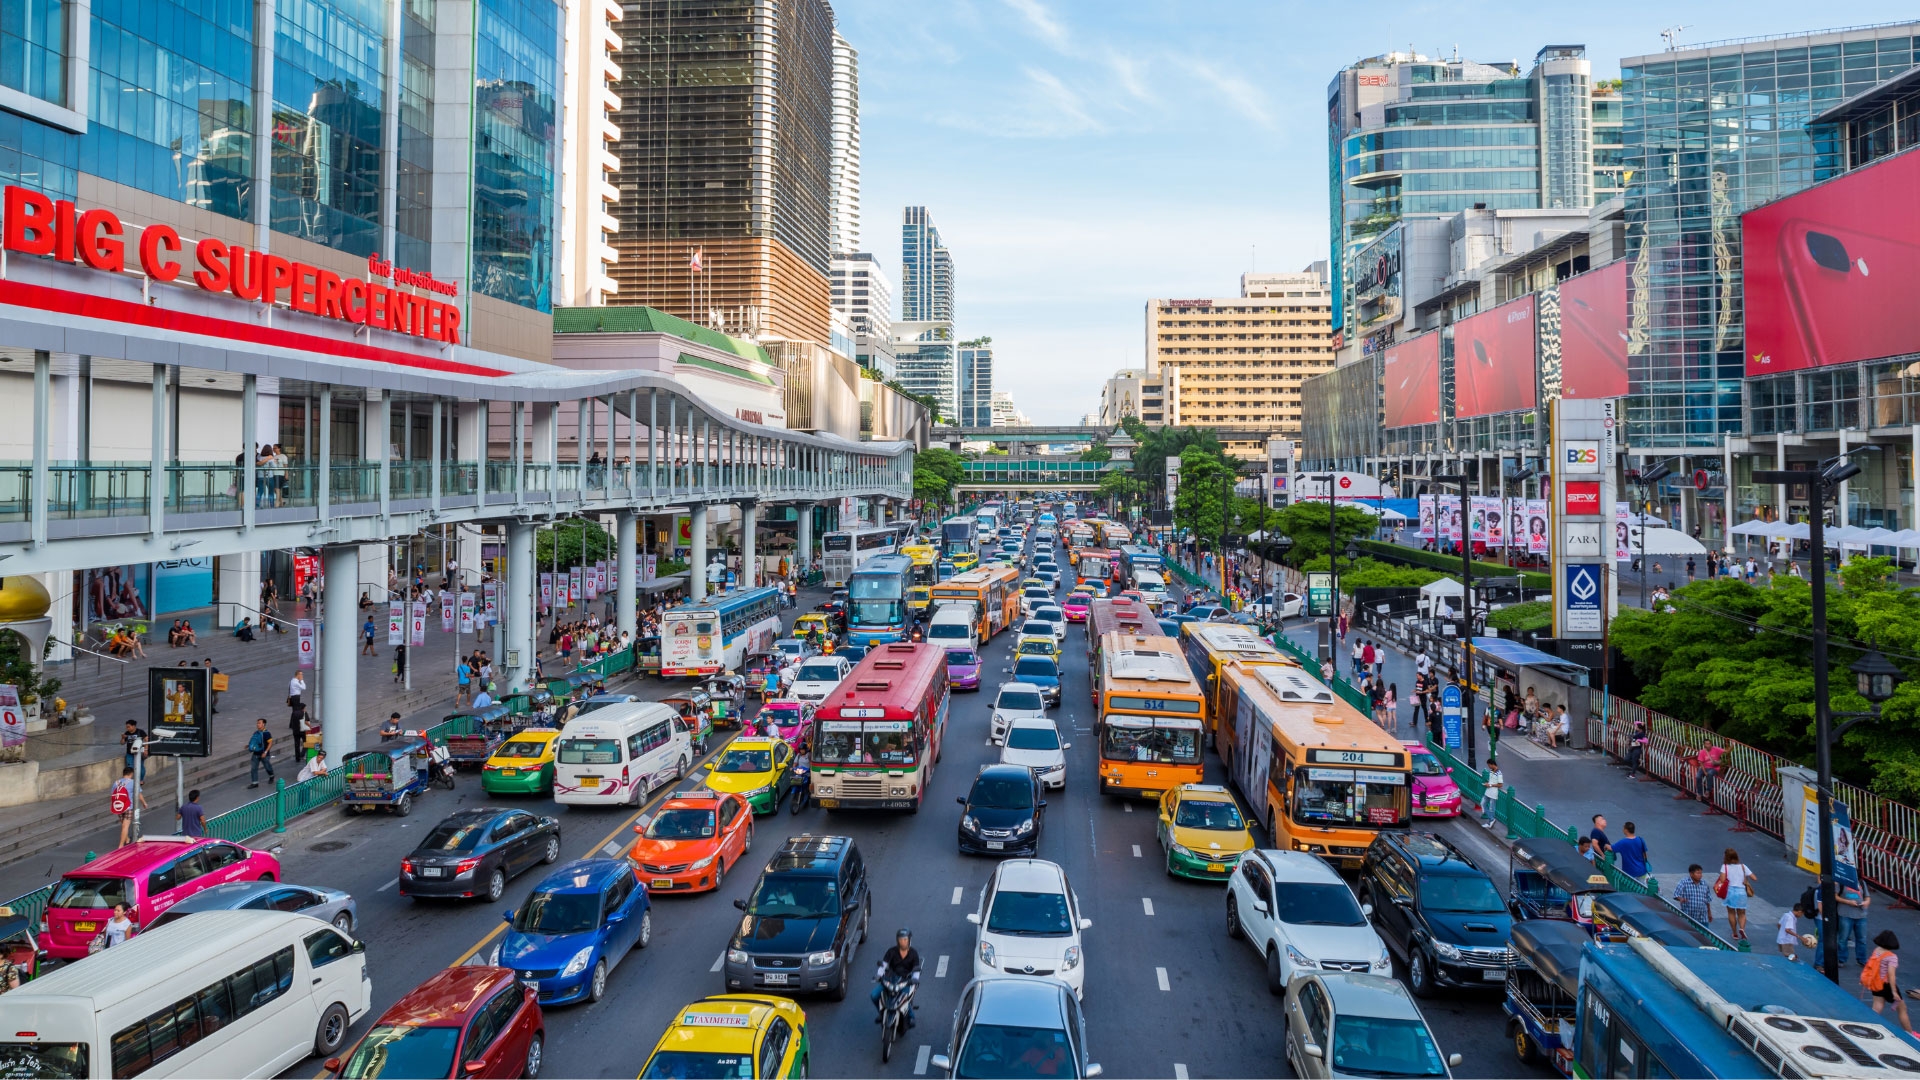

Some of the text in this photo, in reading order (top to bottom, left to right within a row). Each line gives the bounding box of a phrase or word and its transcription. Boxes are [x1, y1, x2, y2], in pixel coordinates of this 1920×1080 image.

[1359, 74, 1388, 86] ZEN
[4, 186, 461, 345] BIG C SUPERCENTER
[1567, 449, 1597, 463] B2S
[1568, 535, 1598, 544] ZARA
[1144, 700, 1164, 709] 514
[858, 709, 867, 717] 13
[1342, 752, 1364, 762] 204
[693, 1015, 741, 1025] TAXIMETER
